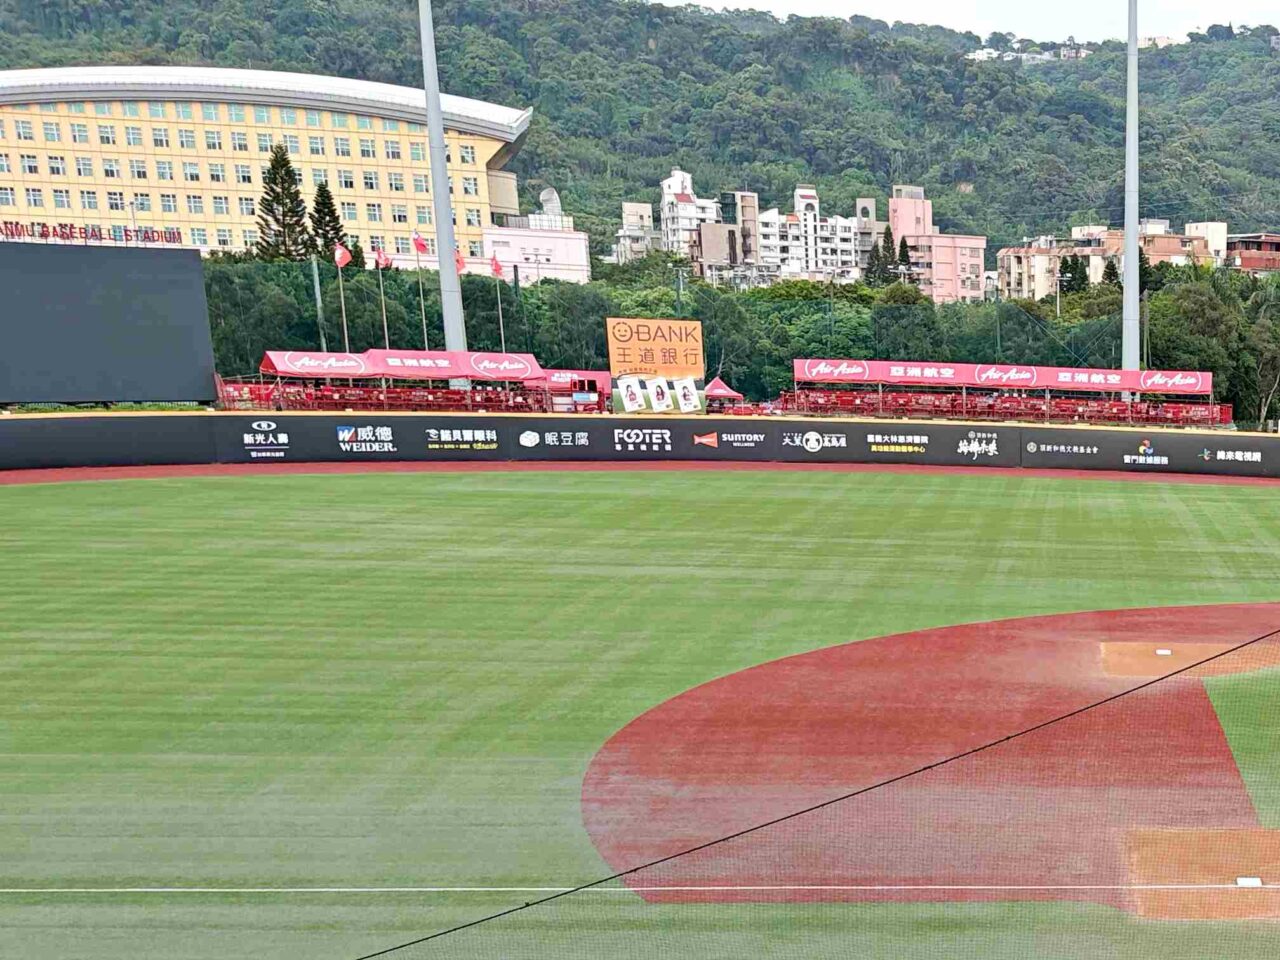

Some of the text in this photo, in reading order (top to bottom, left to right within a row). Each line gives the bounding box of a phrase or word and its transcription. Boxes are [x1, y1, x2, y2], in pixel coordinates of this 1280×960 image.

[41, 223, 115, 242] BASEBALL
[123, 228, 182, 244] STADIUM
[616, 347, 700, 366] 王道銀行
[889, 366, 955, 378] 亞洲航空
[1057, 372, 1121, 384] 亞洲航空
[243, 433, 289, 444] 新光人壽
[357, 426, 393, 441] 威德
[544, 431, 589, 446] 眠豆腐
[614, 429, 672, 443] FOOTER
[339, 442, 394, 452] WEIDER
